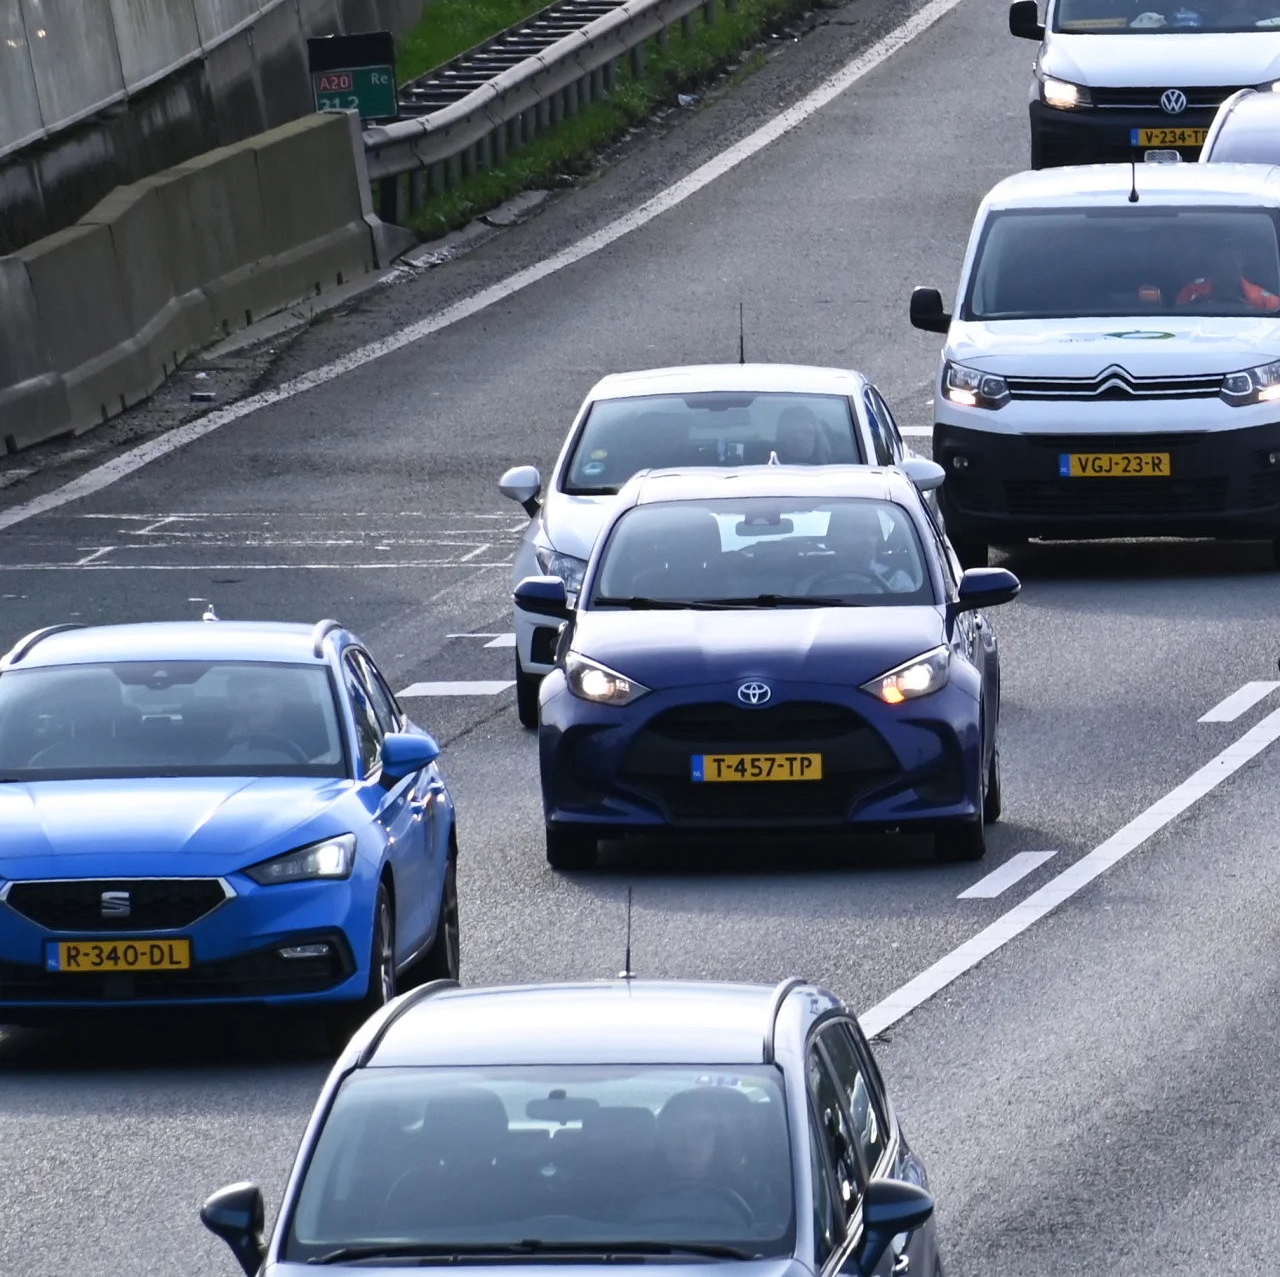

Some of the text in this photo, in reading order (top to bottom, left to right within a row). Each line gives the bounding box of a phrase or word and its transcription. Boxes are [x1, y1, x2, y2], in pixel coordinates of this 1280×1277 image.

[319, 72, 389, 91] A20 Re
[1078, 455, 1163, 474] VGJ-23-R
[712, 756, 813, 778] T-457-TP
[66, 943, 183, 968] R-340-DL
